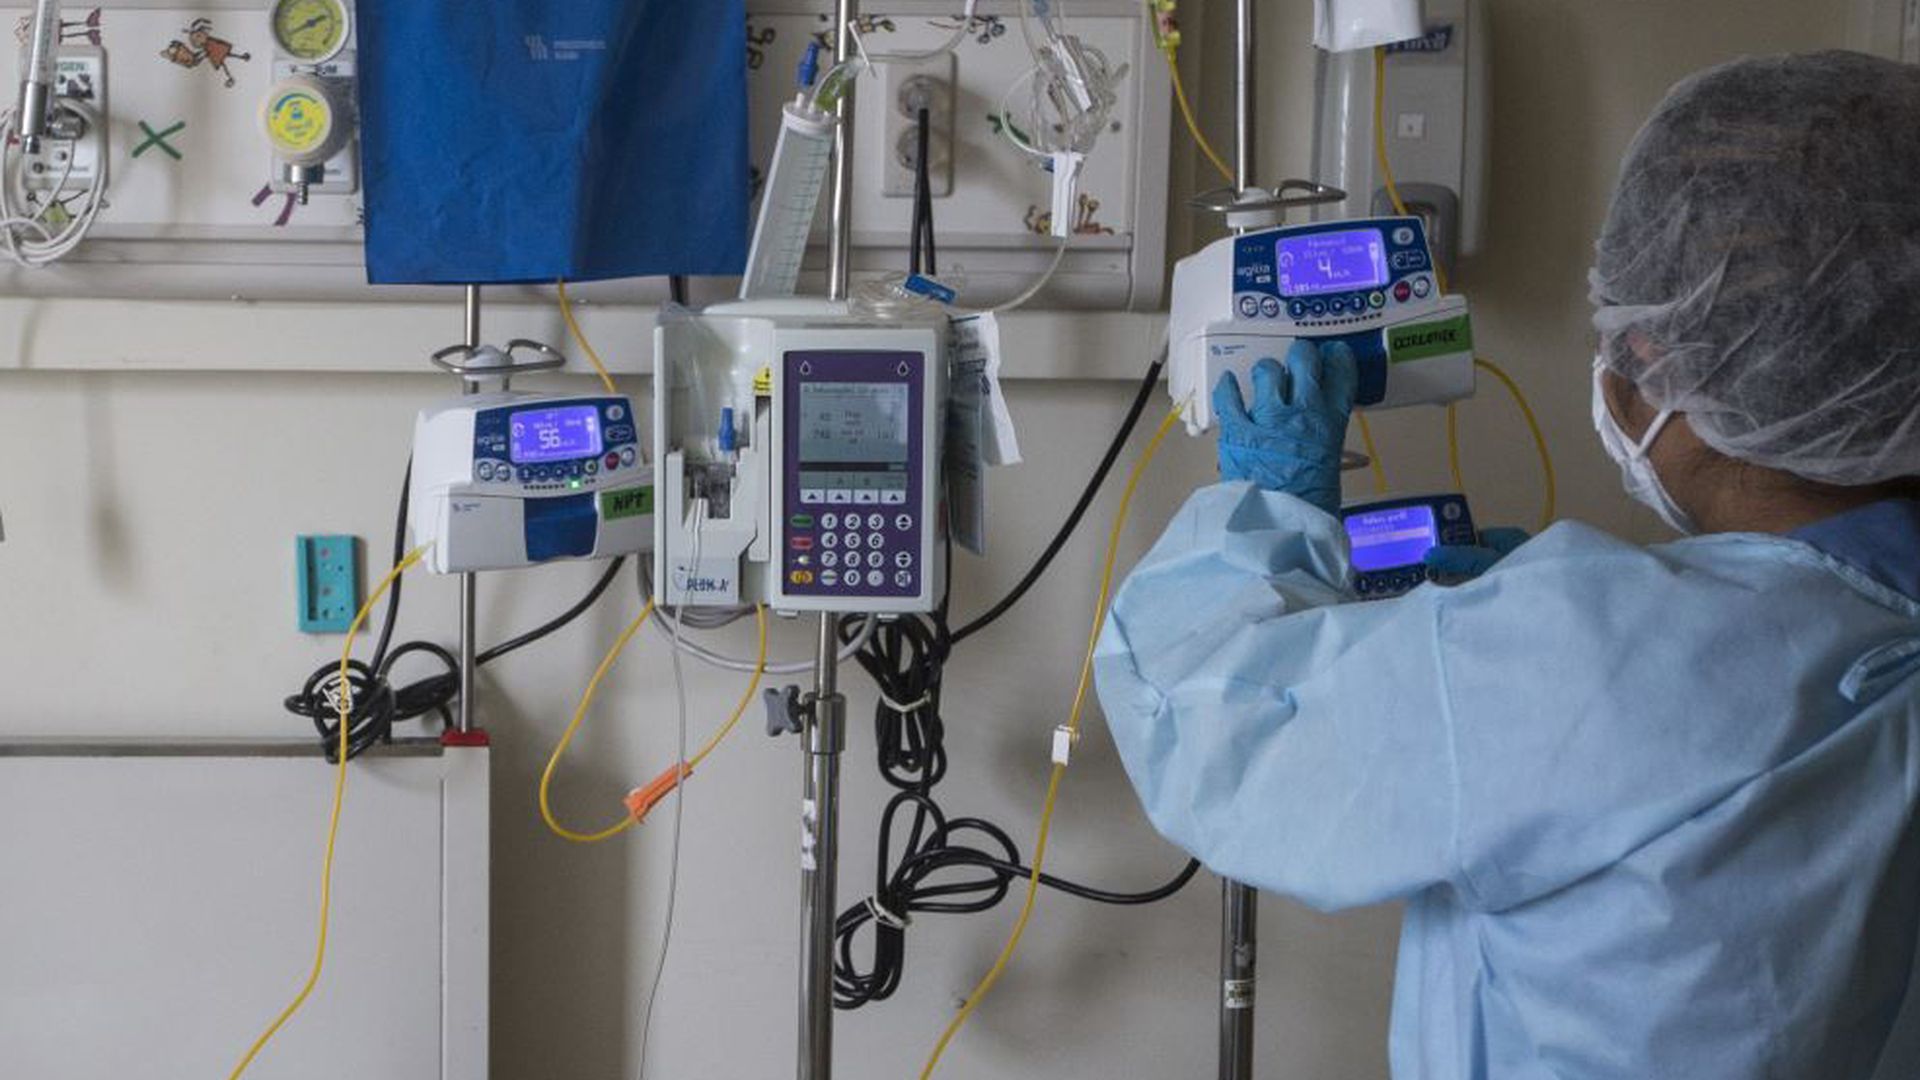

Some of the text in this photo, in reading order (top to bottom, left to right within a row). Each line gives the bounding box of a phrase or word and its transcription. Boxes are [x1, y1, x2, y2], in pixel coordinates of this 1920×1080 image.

[1317, 257, 1333, 280] 4
[538, 428, 561, 450] 56
[612, 492, 647, 513] NPT
[848, 516, 858, 527] 2
[871, 516, 880, 528] 3
[848, 535, 857, 546] 5
[871, 535, 880, 546] 6
[825, 553, 880, 565] 7 8 9
[848, 573, 857, 584] 0
